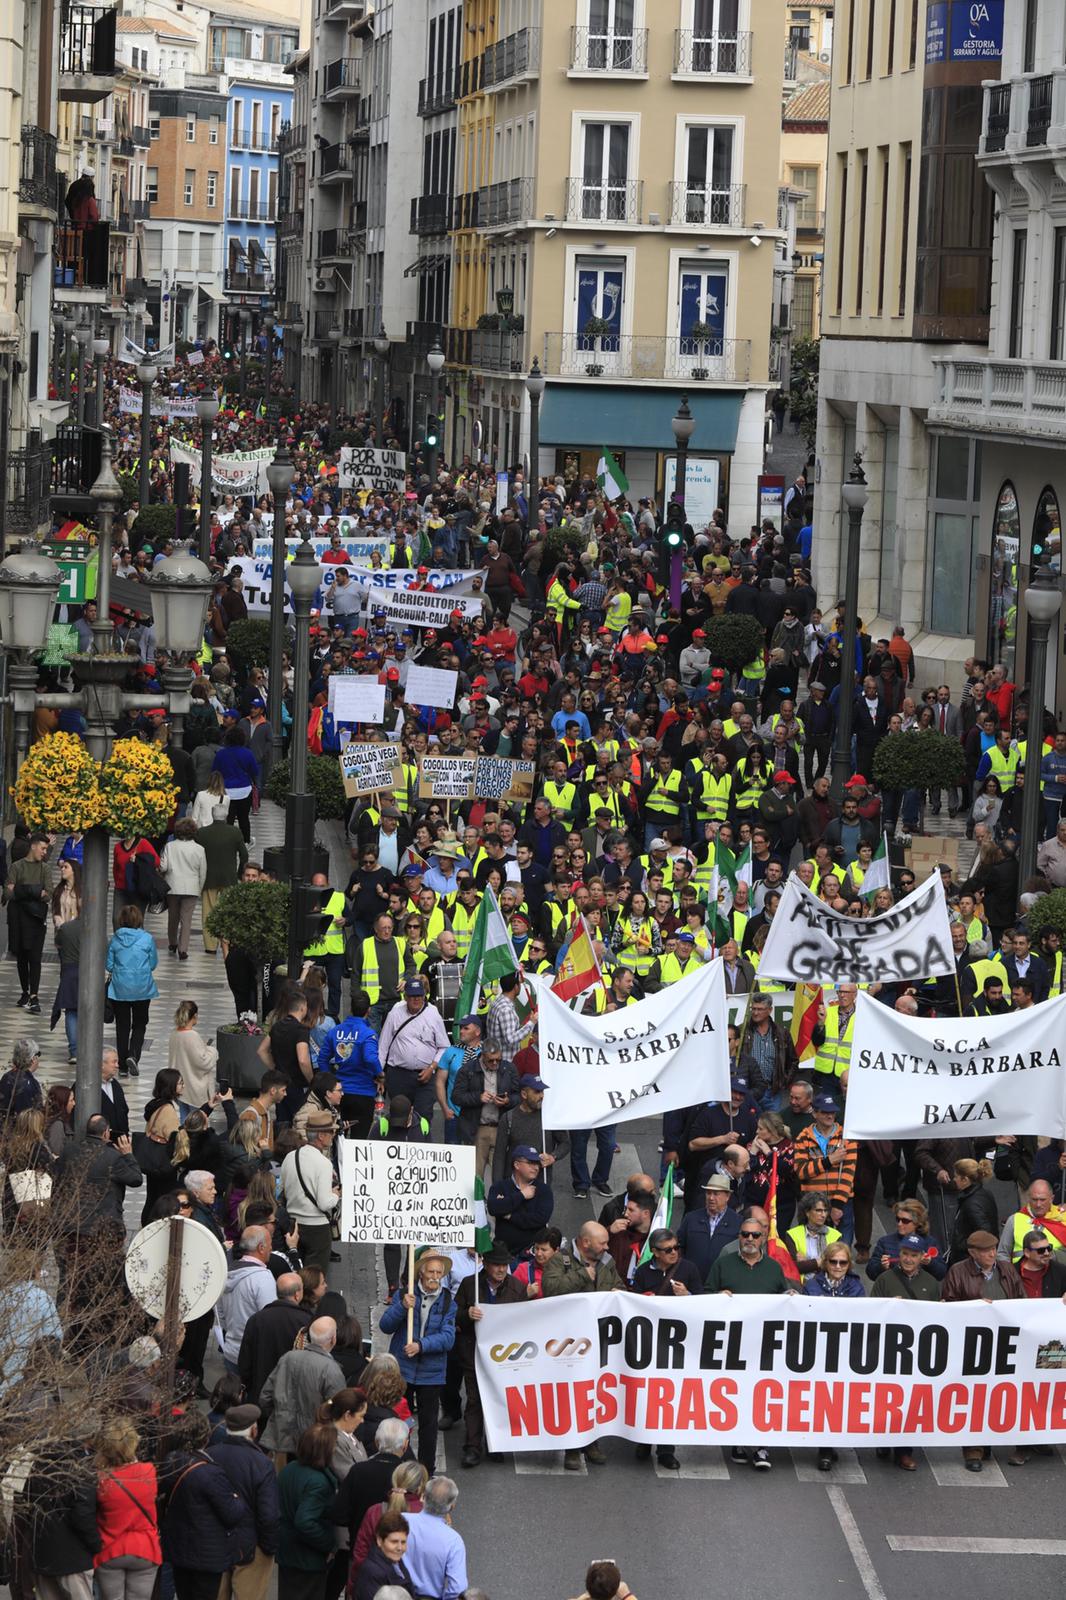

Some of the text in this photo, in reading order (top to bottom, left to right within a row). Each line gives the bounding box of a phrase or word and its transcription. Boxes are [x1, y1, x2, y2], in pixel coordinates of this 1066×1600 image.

[963, 40, 995, 48] GESTORIA
[352, 448, 396, 465] POR UN
[343, 461, 382, 476] PRECIO
[352, 477, 399, 491] LA VIÑA
[373, 573, 397, 588] SE
[392, 592, 467, 611] AGRICULTORES
[343, 746, 398, 767] COGOLLOS VEGA
[361, 761, 385, 775] CON LOS
[423, 759, 457, 770] COGOLLOS
[478, 757, 533, 772] COGOLLOS VEGA
[357, 772, 392, 790] AGRICULTORES
[440, 772, 462, 782] CON LOS
[477, 767, 512, 780] POR UNOS
[433, 783, 468, 796] AGRICULTORES
[475, 777, 511, 790] PRECIOS
[474, 787, 502, 798] DIGNOS
[787, 934, 952, 983] GRANADA
[932, 1036, 991, 1054] S.C.A
[547, 1041, 610, 1065] SANTA
[858, 1047, 1062, 1076] SANTA BÁRBARA
[922, 1100, 996, 1125] BAZA
[353, 1198, 374, 1213] NO
[348, 1229, 368, 1241] NO
[597, 1315, 1021, 1377] POR EL FUTURO DE
[505, 1371, 1066, 1437] NUESTRAS GENERACIONE
